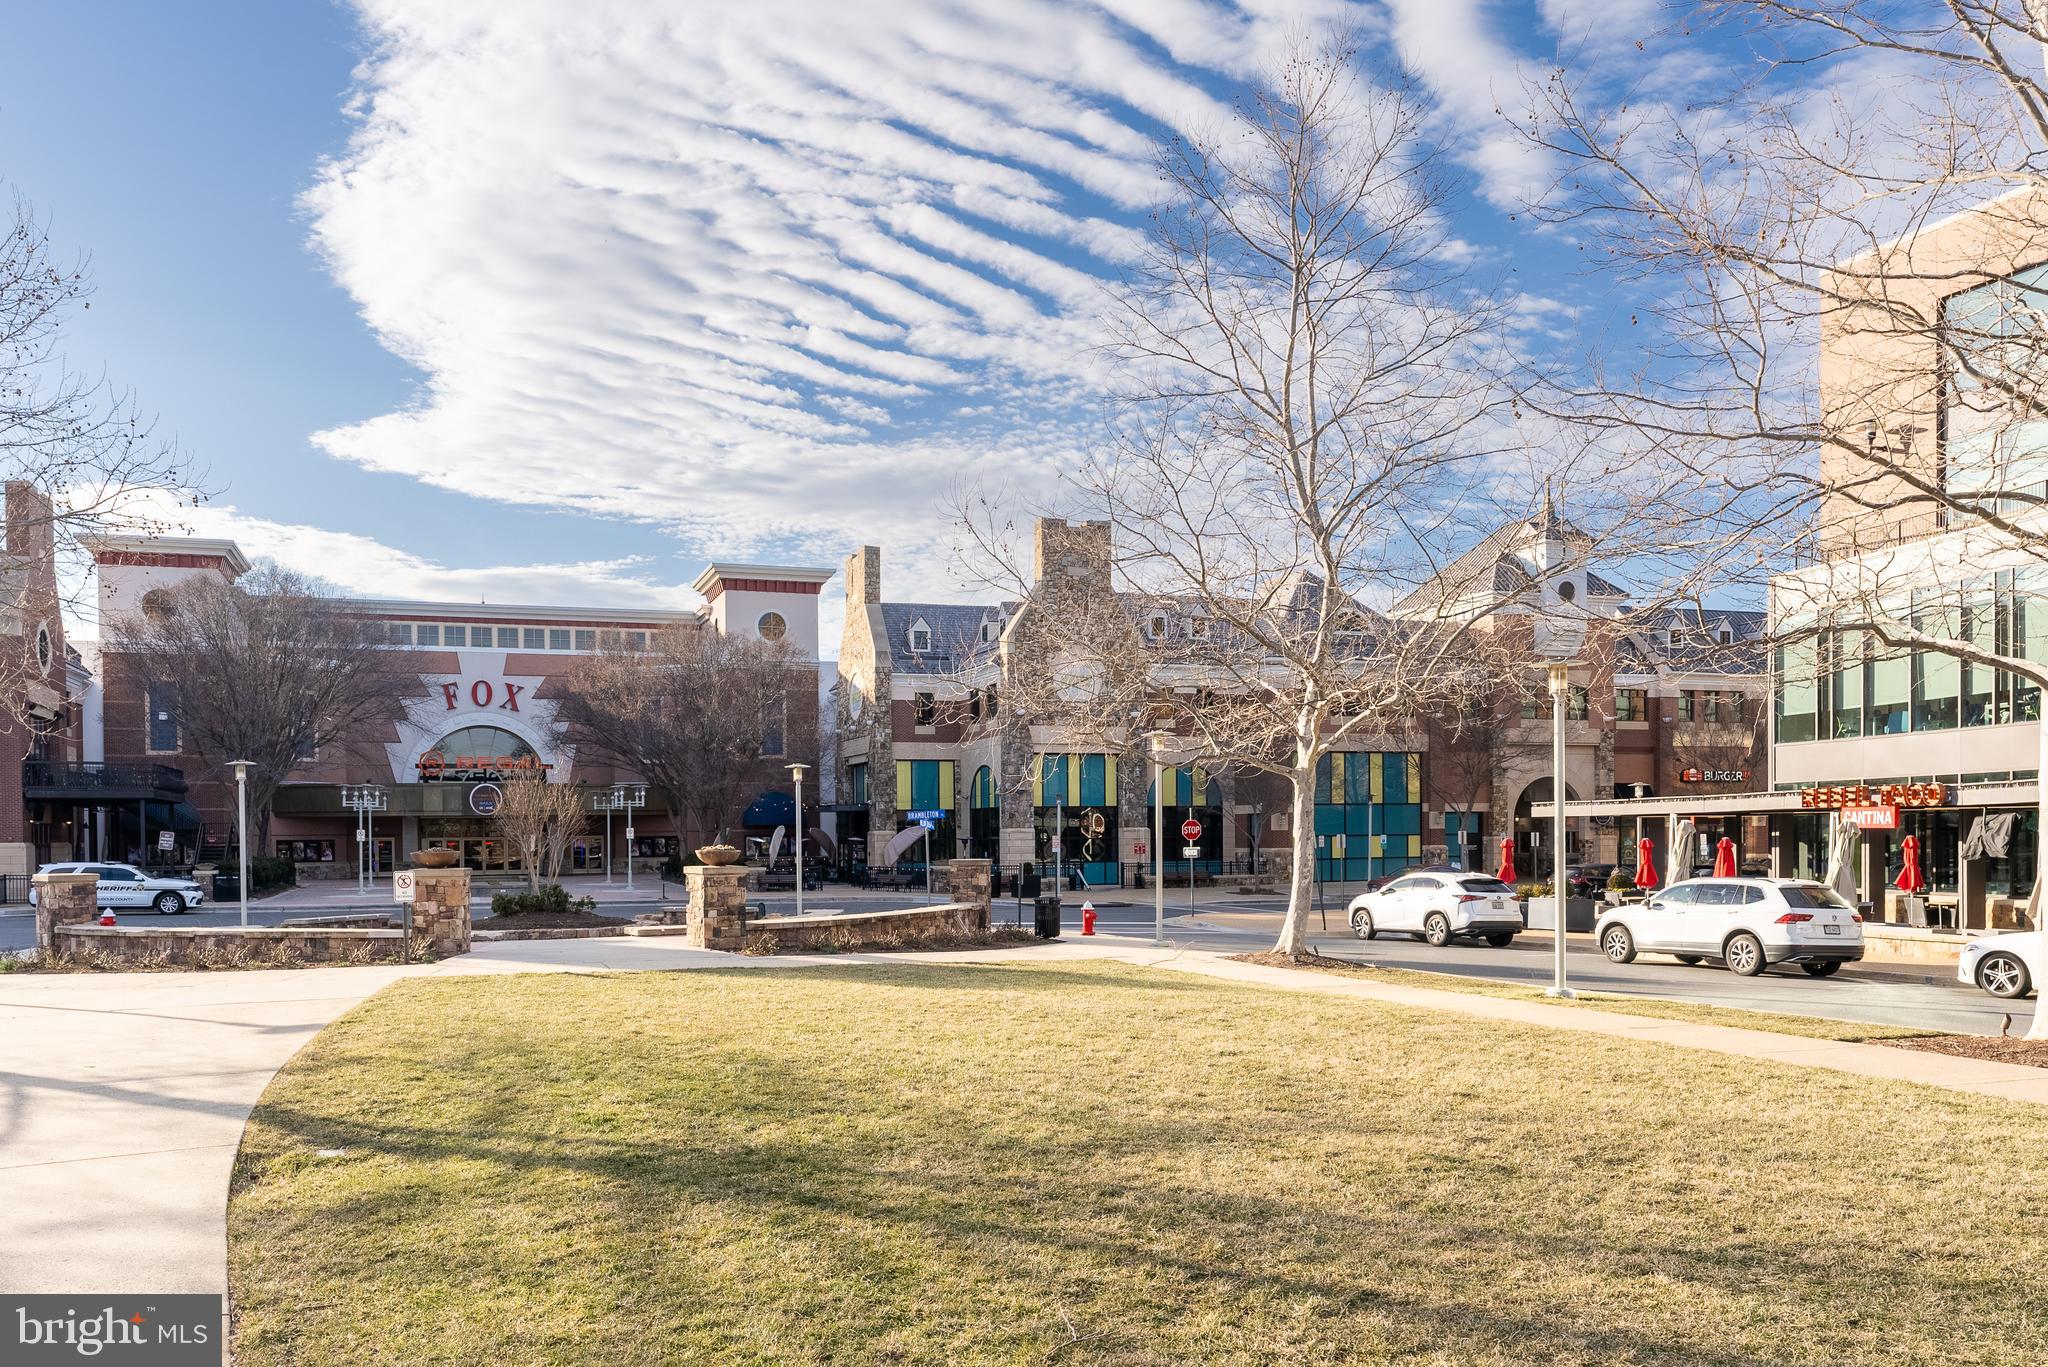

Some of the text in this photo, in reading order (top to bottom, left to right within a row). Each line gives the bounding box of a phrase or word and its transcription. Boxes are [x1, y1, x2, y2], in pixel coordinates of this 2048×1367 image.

[440, 680, 525, 712] FOX
[1802, 782, 1943, 808] REBEL TACO
[907, 810, 939, 819] BRAMBLETON
[1843, 809, 1892, 825] CANTINA
[1183, 825, 1200, 835] STOP
